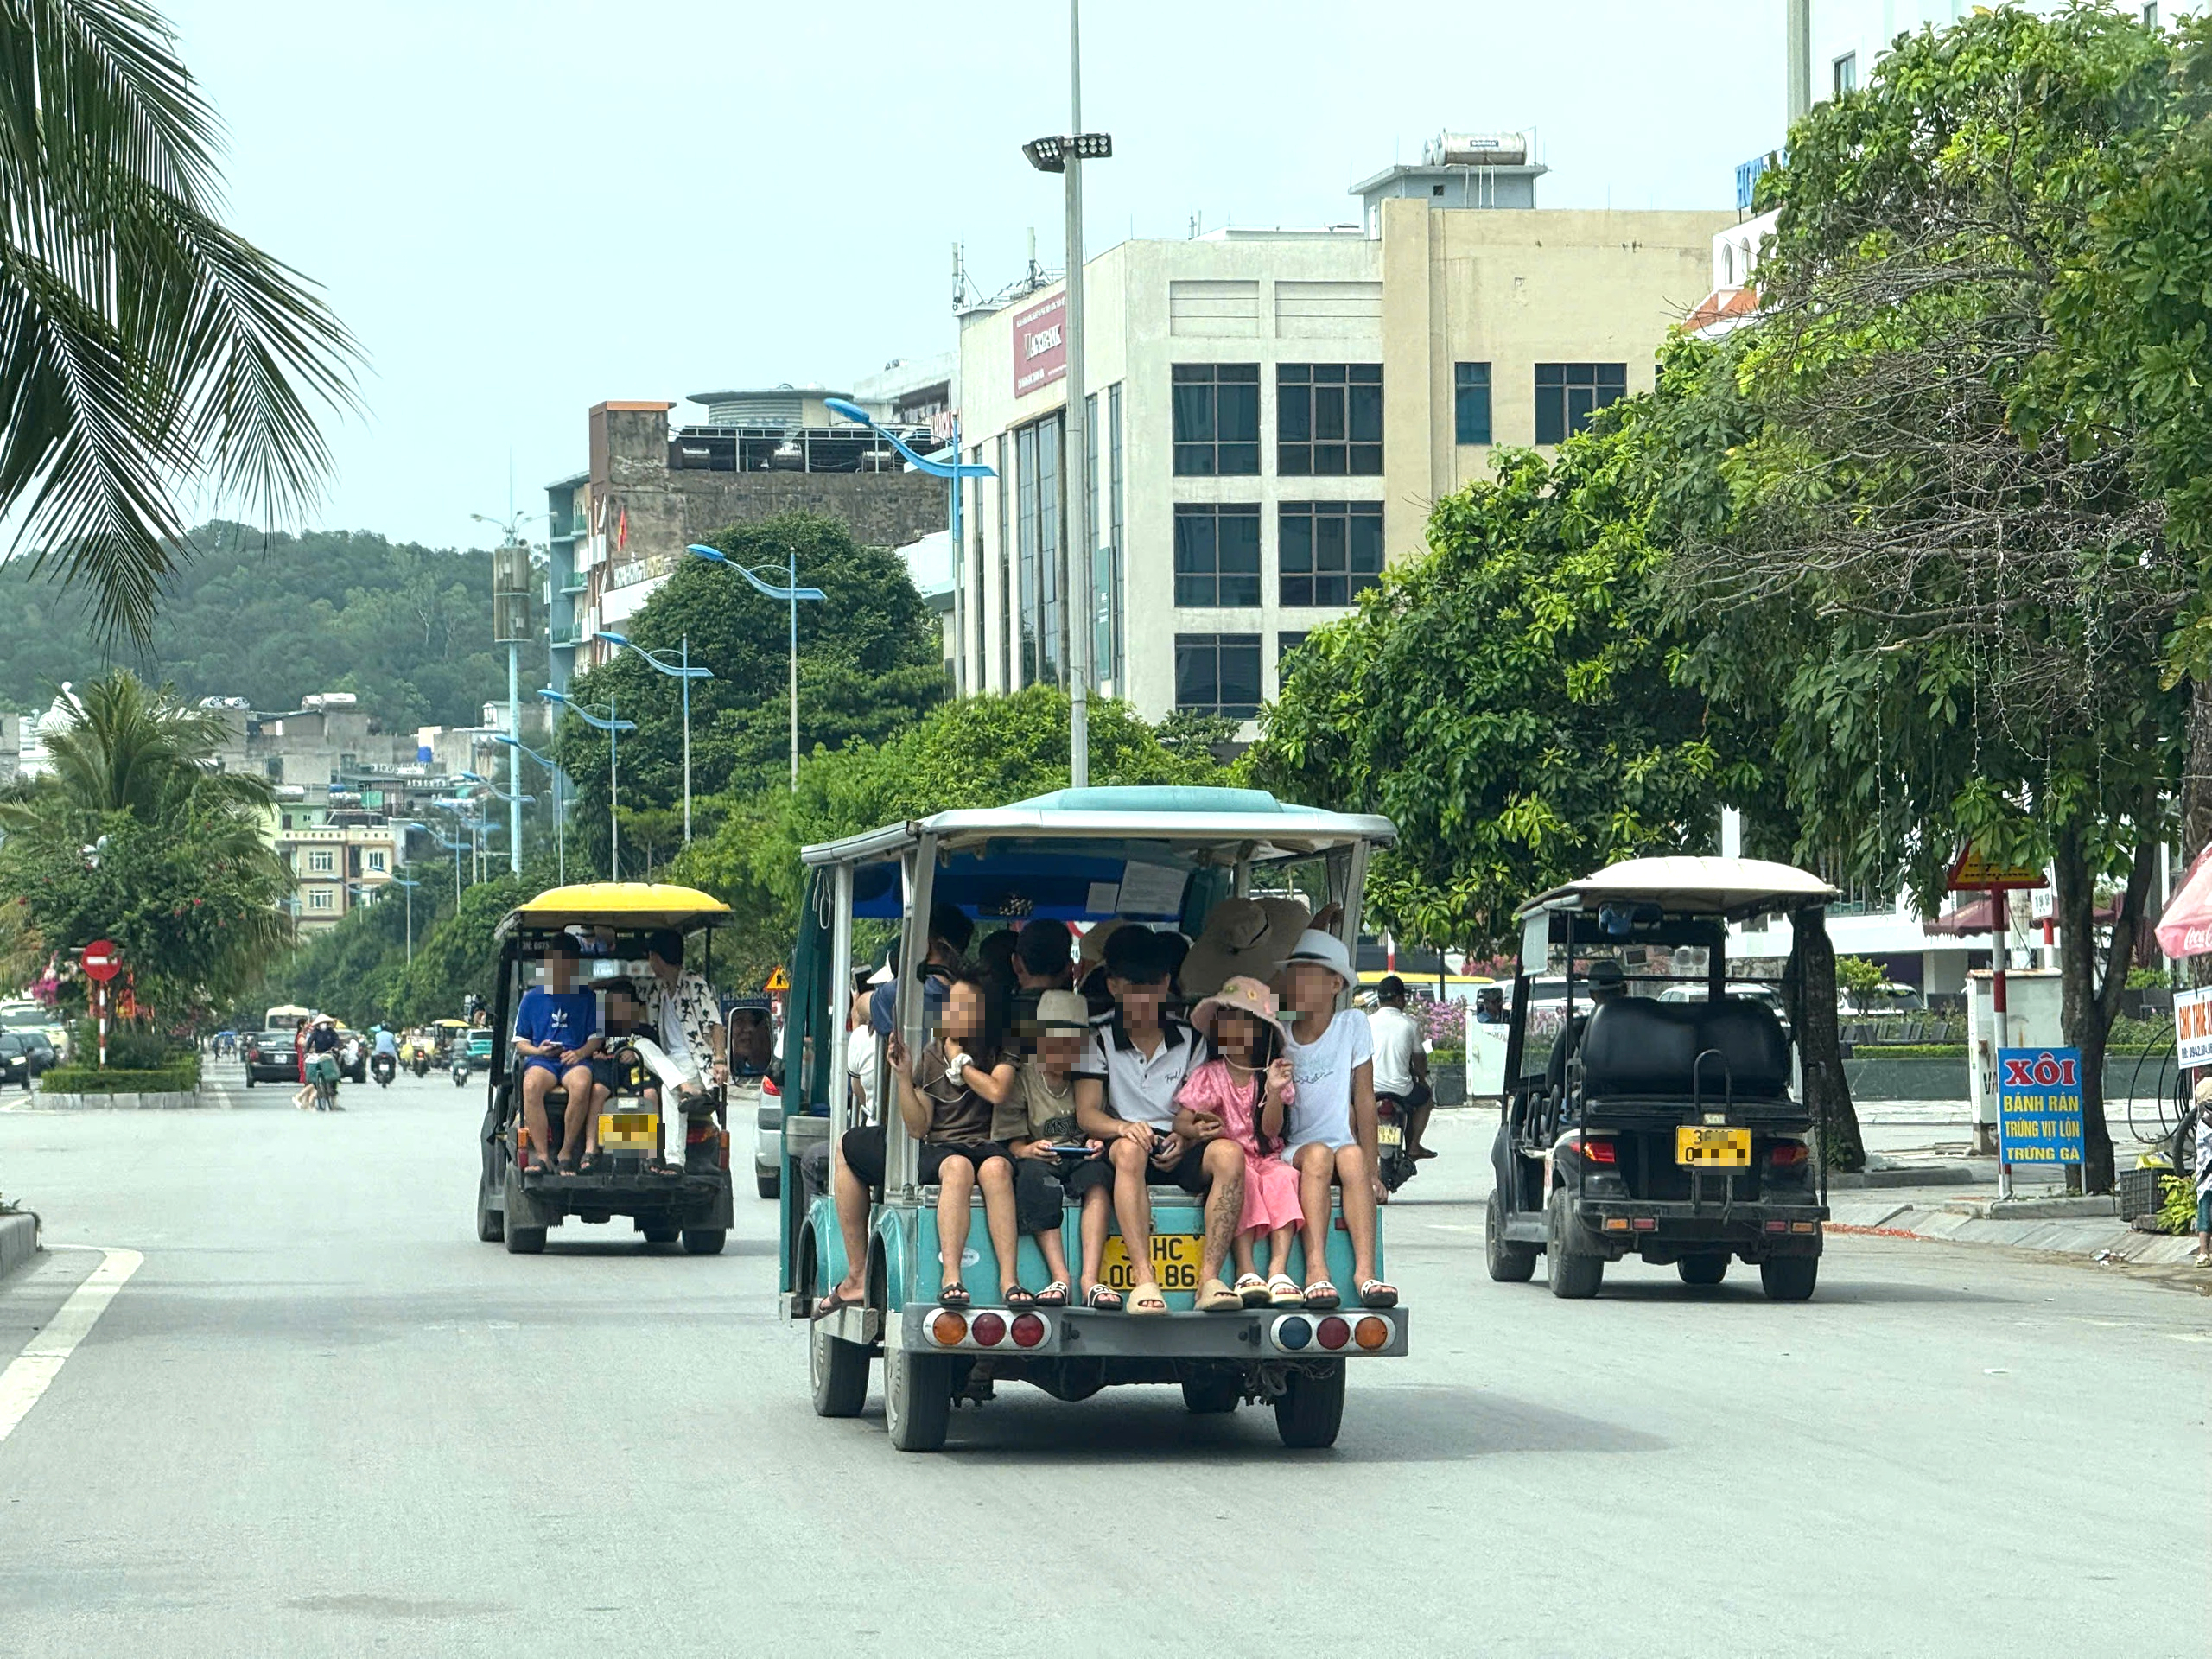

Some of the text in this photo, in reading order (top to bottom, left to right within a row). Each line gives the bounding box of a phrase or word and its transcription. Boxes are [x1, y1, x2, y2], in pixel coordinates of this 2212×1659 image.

[2179, 1005, 2191, 1041] CHO
[2005, 1052, 2077, 1086] XÔI
[2004, 1091, 2079, 1112] BÁNH RÁN
[2005, 1117, 2080, 1141] TRỨNG VỊT LỘN
[2006, 1145, 2080, 1160] TRỨNG GÀ
[1109, 1264, 1195, 1287] 00.86
